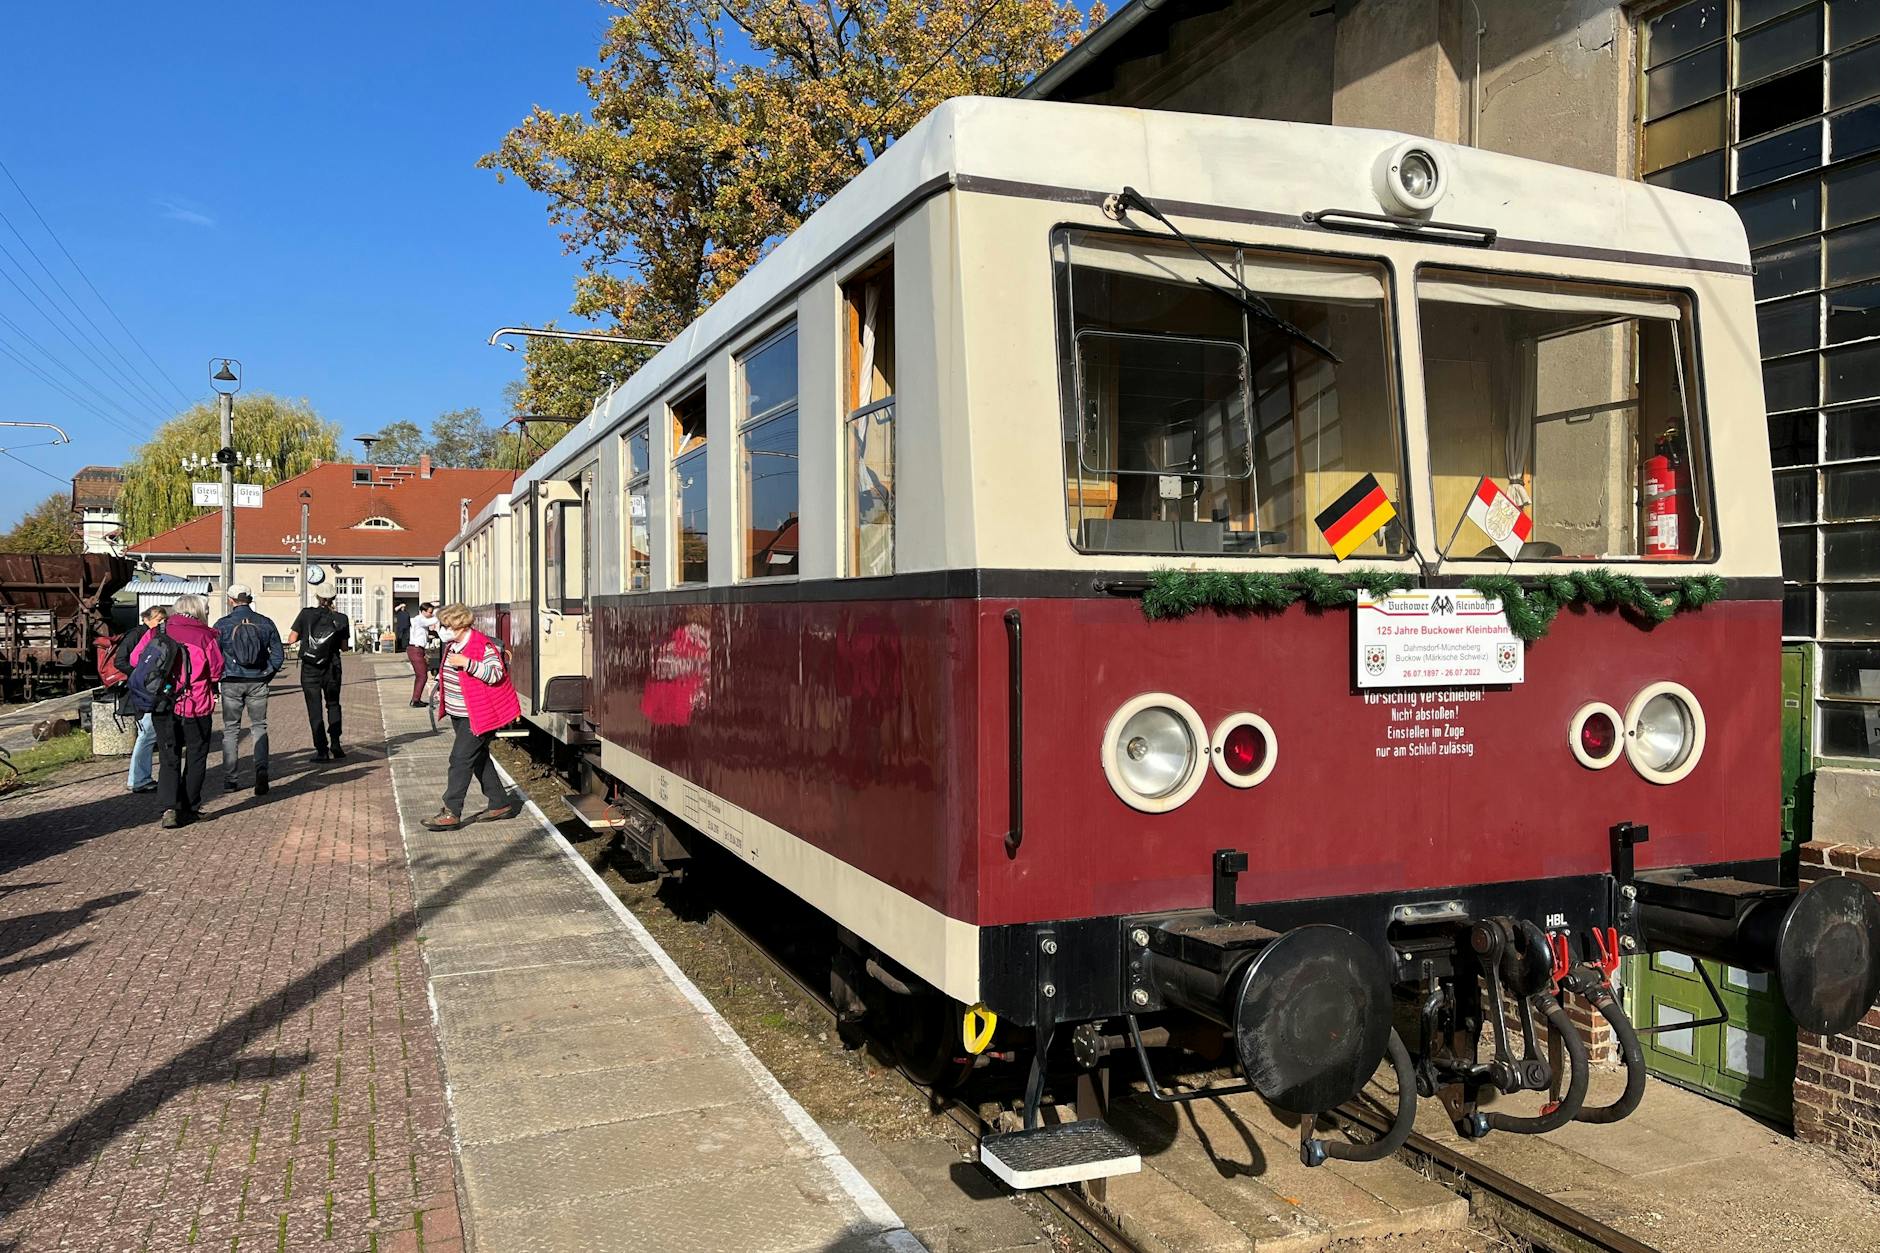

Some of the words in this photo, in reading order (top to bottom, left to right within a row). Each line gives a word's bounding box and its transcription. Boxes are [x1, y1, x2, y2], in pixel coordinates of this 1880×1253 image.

[197, 486, 217, 495] Gleis
[240, 488, 260, 496] Gleis
[204, 494, 209, 502] 2
[1388, 600, 1429, 611] Buckower
[1456, 600, 1495, 611] Kleinbahn
[1377, 626, 1392, 635] 125
[1394, 625, 1419, 635] Jahre
[1421, 625, 1464, 635] Buckower
[1466, 624, 1509, 634] Kleinbahn
[1403, 643, 1481, 652] Dahmsdorf-Müncheberg
[1395, 654, 1421, 662] Buckow
[1423, 653, 1458, 663] (Märkische
[1460, 652, 1489, 662] Schweiz)
[1403, 669, 1440, 678] 26.07.1897
[1445, 668, 1481, 677] 26.07.2022
[1363, 690, 1417, 707] Vorsichtig
[1420, 686, 1485, 702] verschieben!
[1391, 708, 1412, 721] Nicht
[1415, 705, 1459, 720] abstoßen!
[1387, 725, 1430, 739] Einstellen
[1432, 725, 1442, 738] im
[1444, 723, 1465, 740] Zuge
[1375, 746, 1391, 758] nur
[1393, 746, 1407, 757] am
[1409, 742, 1437, 756] Schluß
[1439, 741, 1474, 756] zulässig
[1546, 913, 1568, 927] HBL
